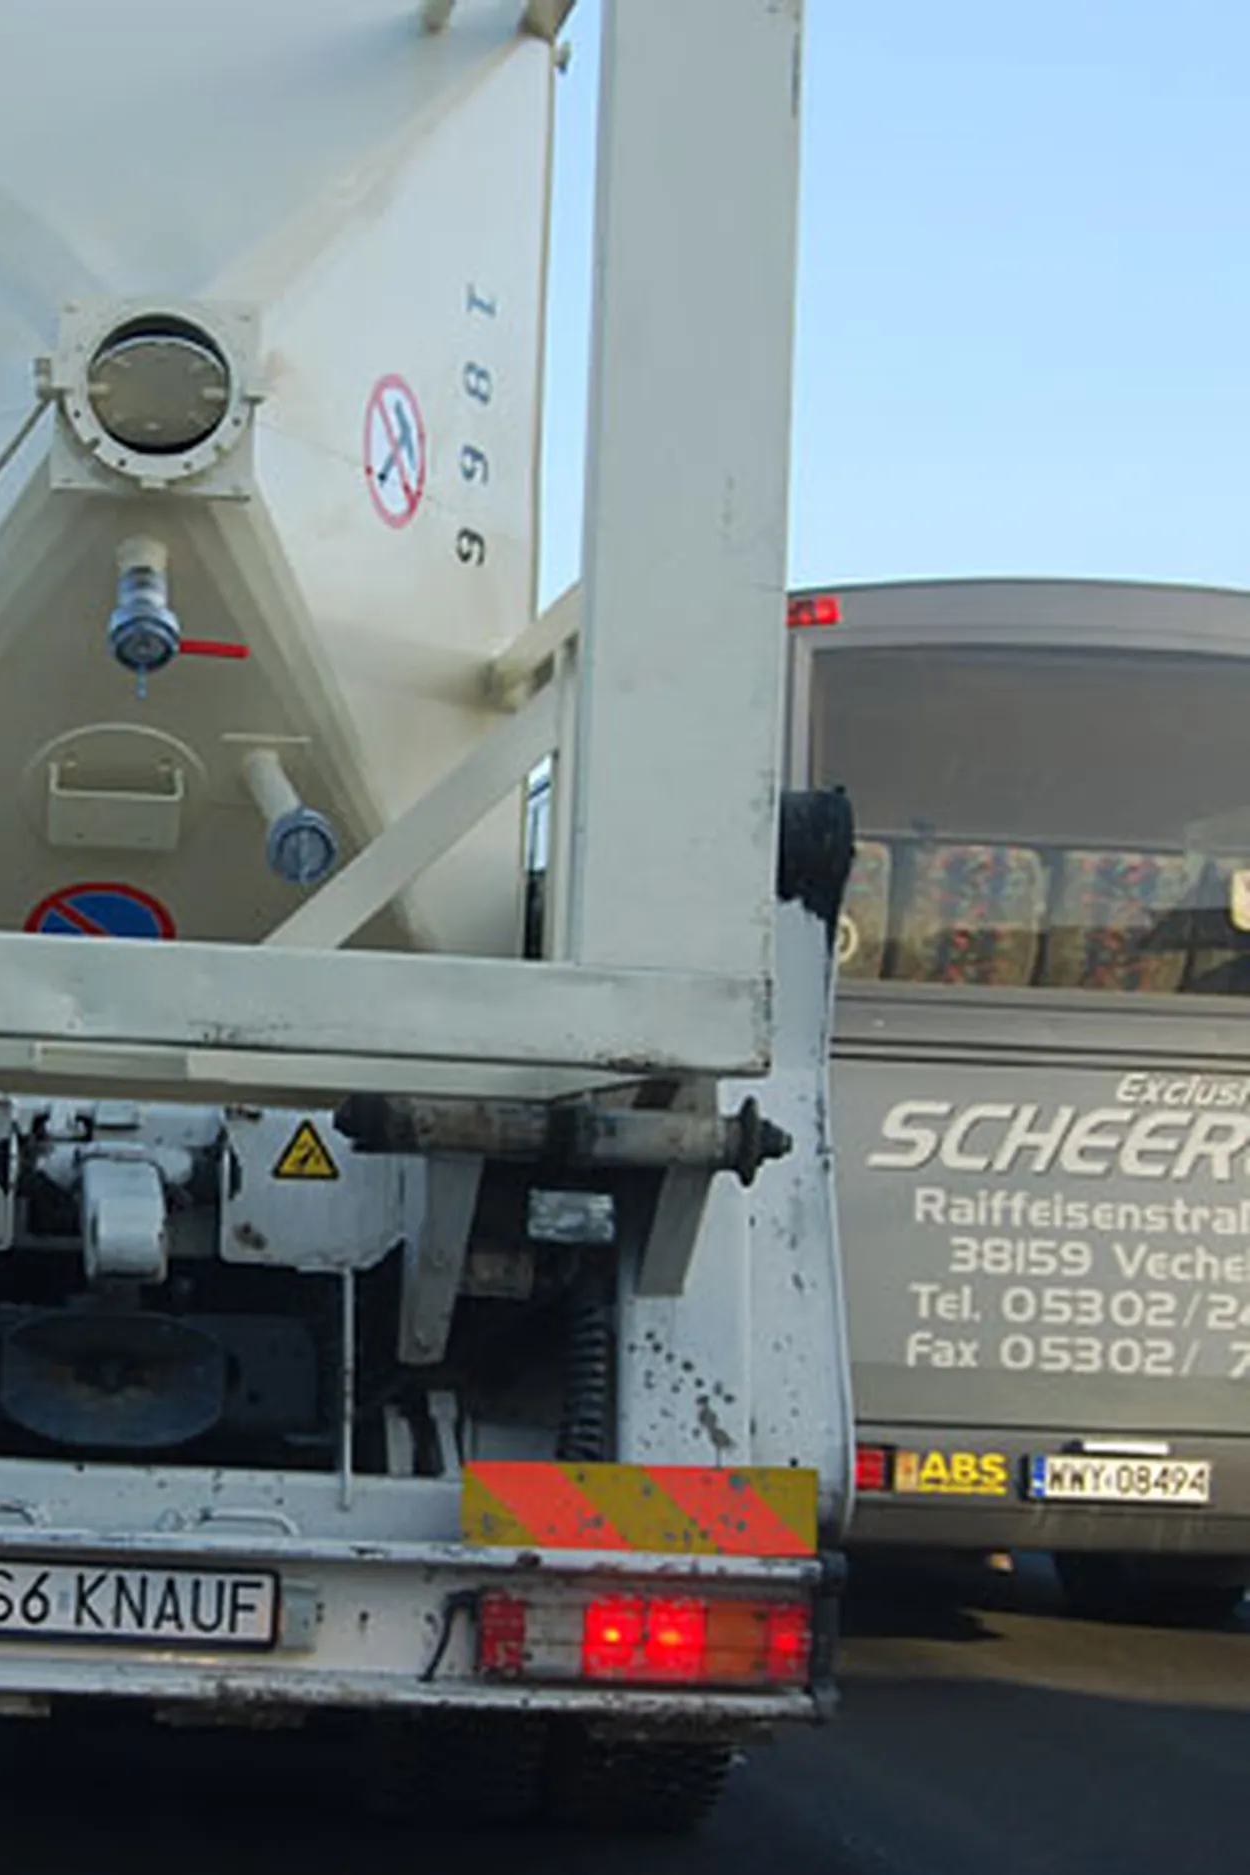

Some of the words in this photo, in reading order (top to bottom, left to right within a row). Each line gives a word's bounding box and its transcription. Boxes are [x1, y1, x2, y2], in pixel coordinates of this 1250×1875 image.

[865, 1100, 1250, 1182] SCHEER
[949, 1236, 1093, 1277] 38159
[908, 1282, 981, 1323] Tel.
[906, 1331, 979, 1369] Fax
[918, 1450, 1009, 1485] ABS
[75, 1571, 265, 1635] KNAUF
